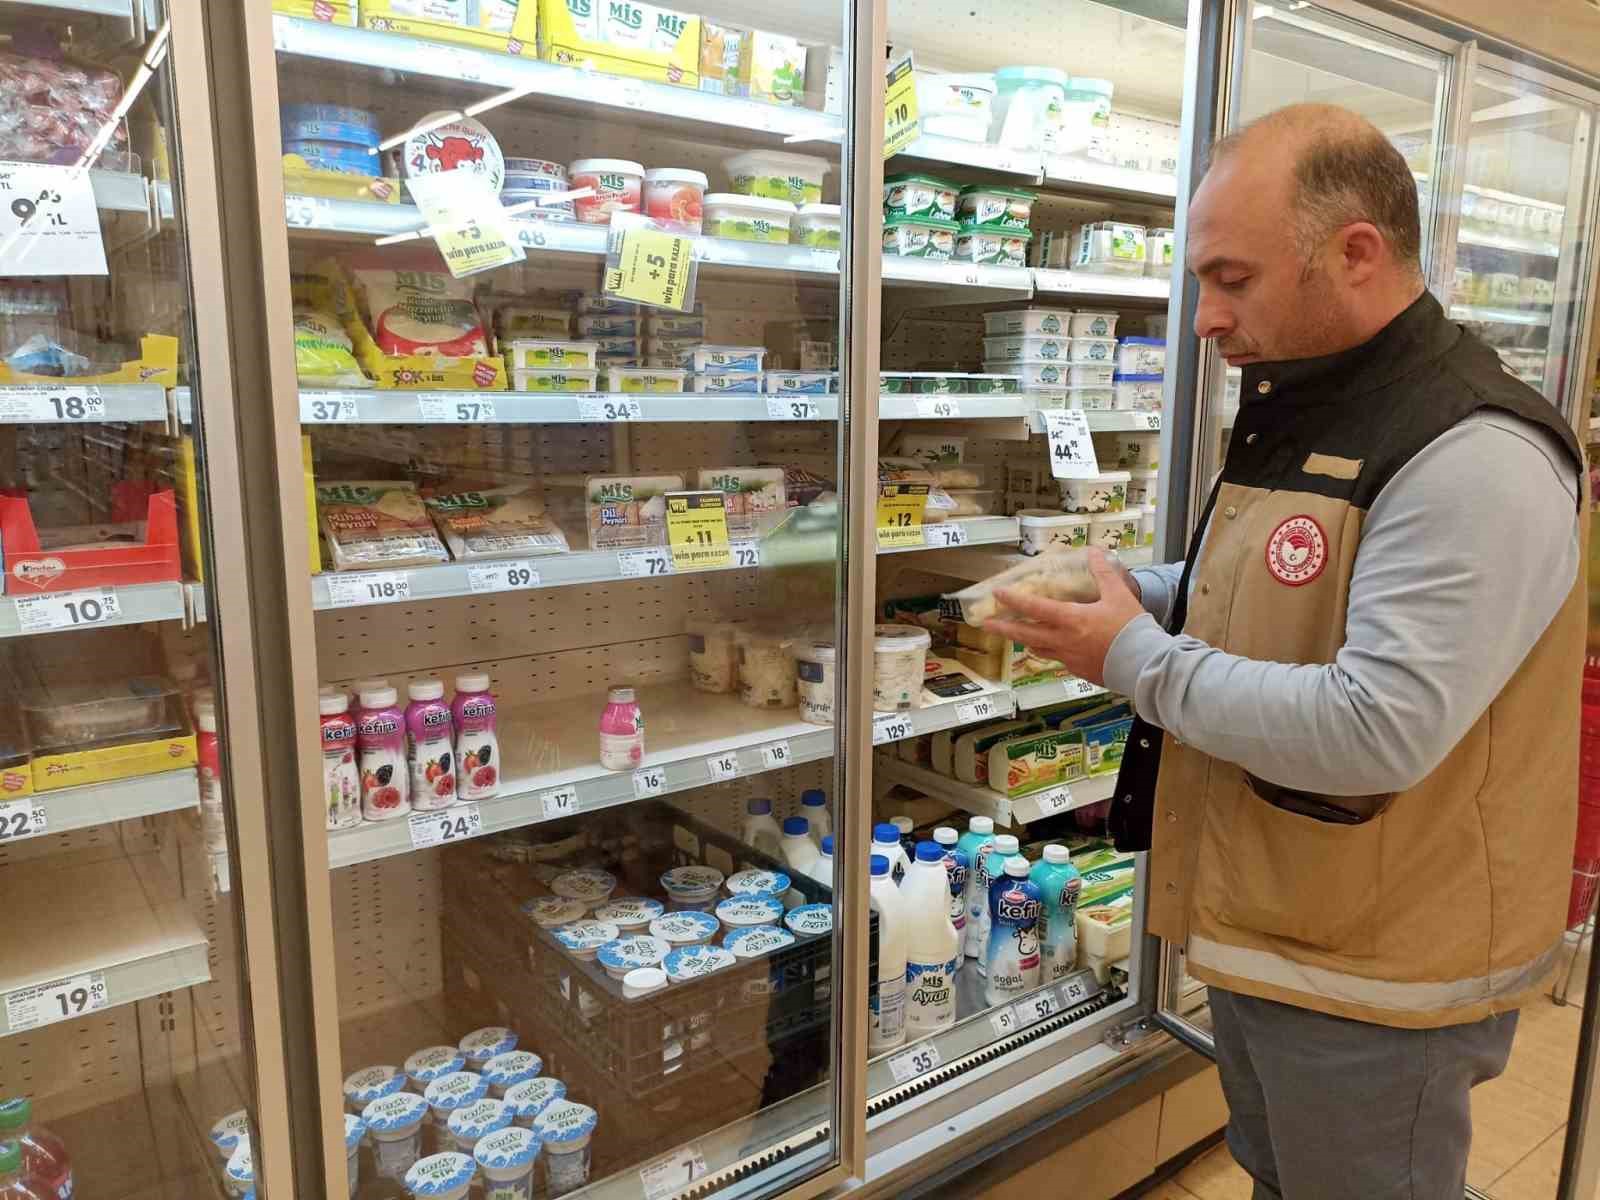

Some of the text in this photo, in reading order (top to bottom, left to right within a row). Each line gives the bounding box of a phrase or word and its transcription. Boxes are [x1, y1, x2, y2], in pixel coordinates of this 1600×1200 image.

[457, 404, 480, 420] 57
[604, 403, 630, 419] 34
[791, 403, 809, 418] 37
[507, 569, 530, 586] 89
[367, 582, 395, 598] 118
[64, 599, 102, 623] 10
[886, 724, 905, 739] 129
[644, 776, 658, 788] 16
[440, 817, 469, 840] 24
[56, 988, 88, 1015] 19
[1036, 1000, 1053, 1017] 52
[913, 1053, 932, 1072] 35
